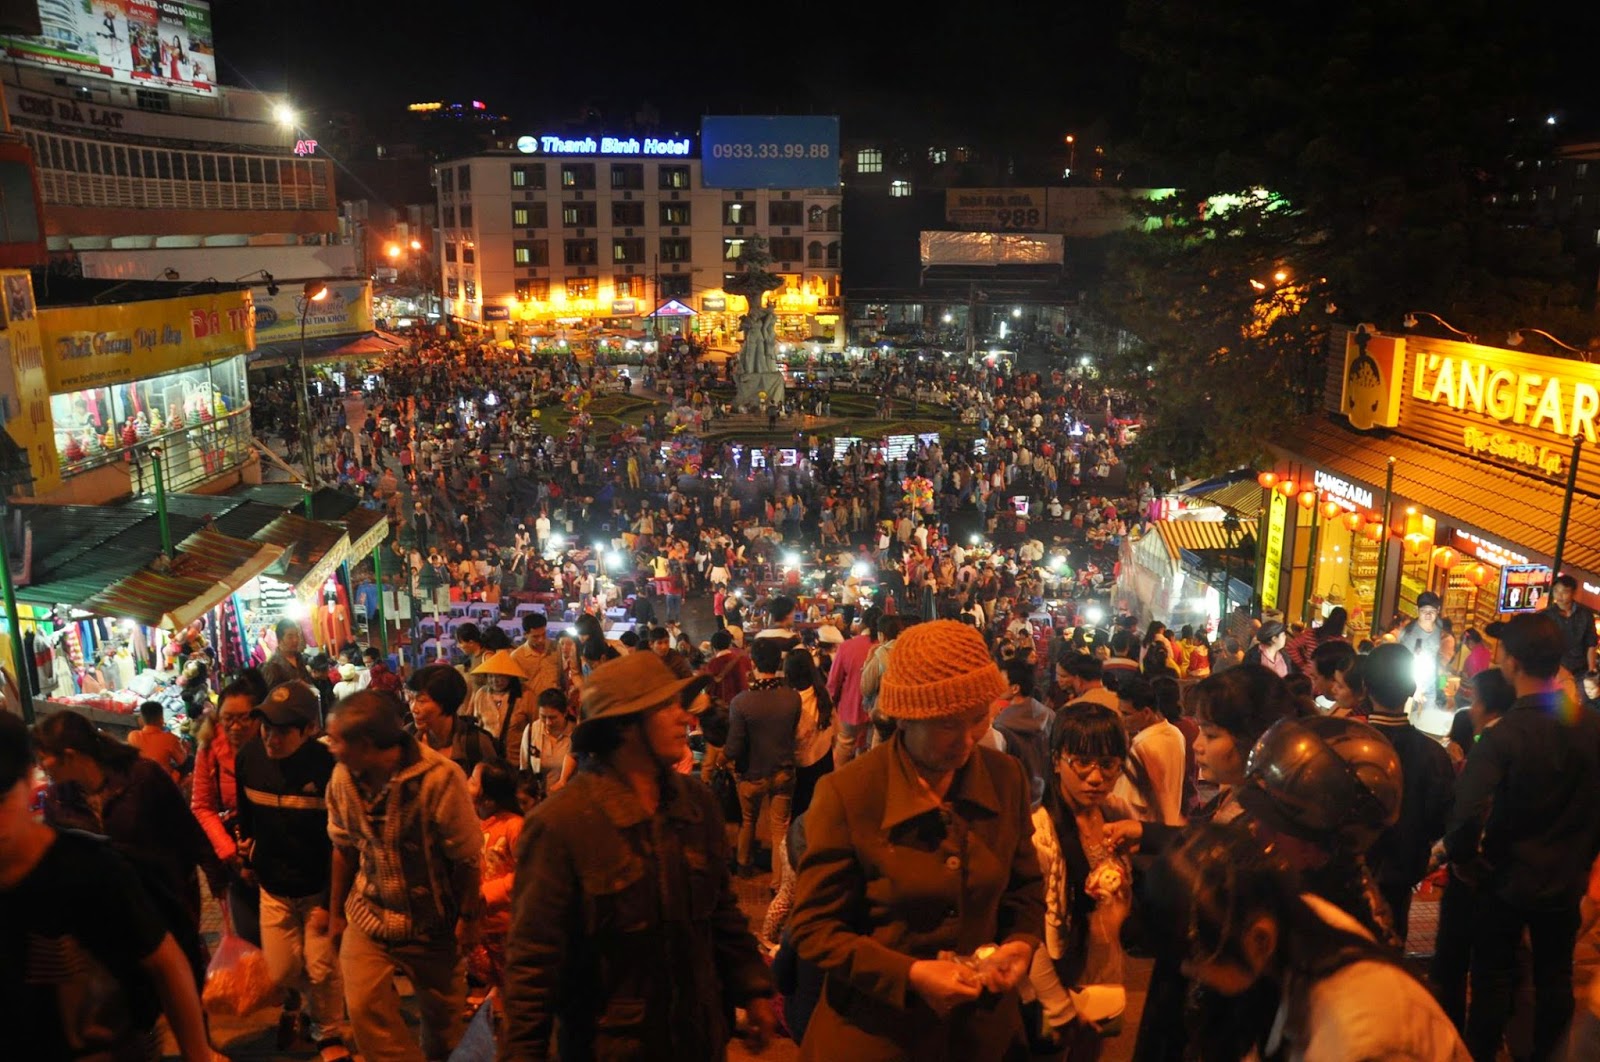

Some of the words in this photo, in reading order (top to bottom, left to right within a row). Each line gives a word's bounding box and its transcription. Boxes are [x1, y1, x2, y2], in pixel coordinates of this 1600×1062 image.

[541, 136, 597, 153] Thanh
[643, 138, 690, 155] Hotel
[712, 143, 830, 159] 0933.33.99.88
[997, 208, 1040, 227] 988
